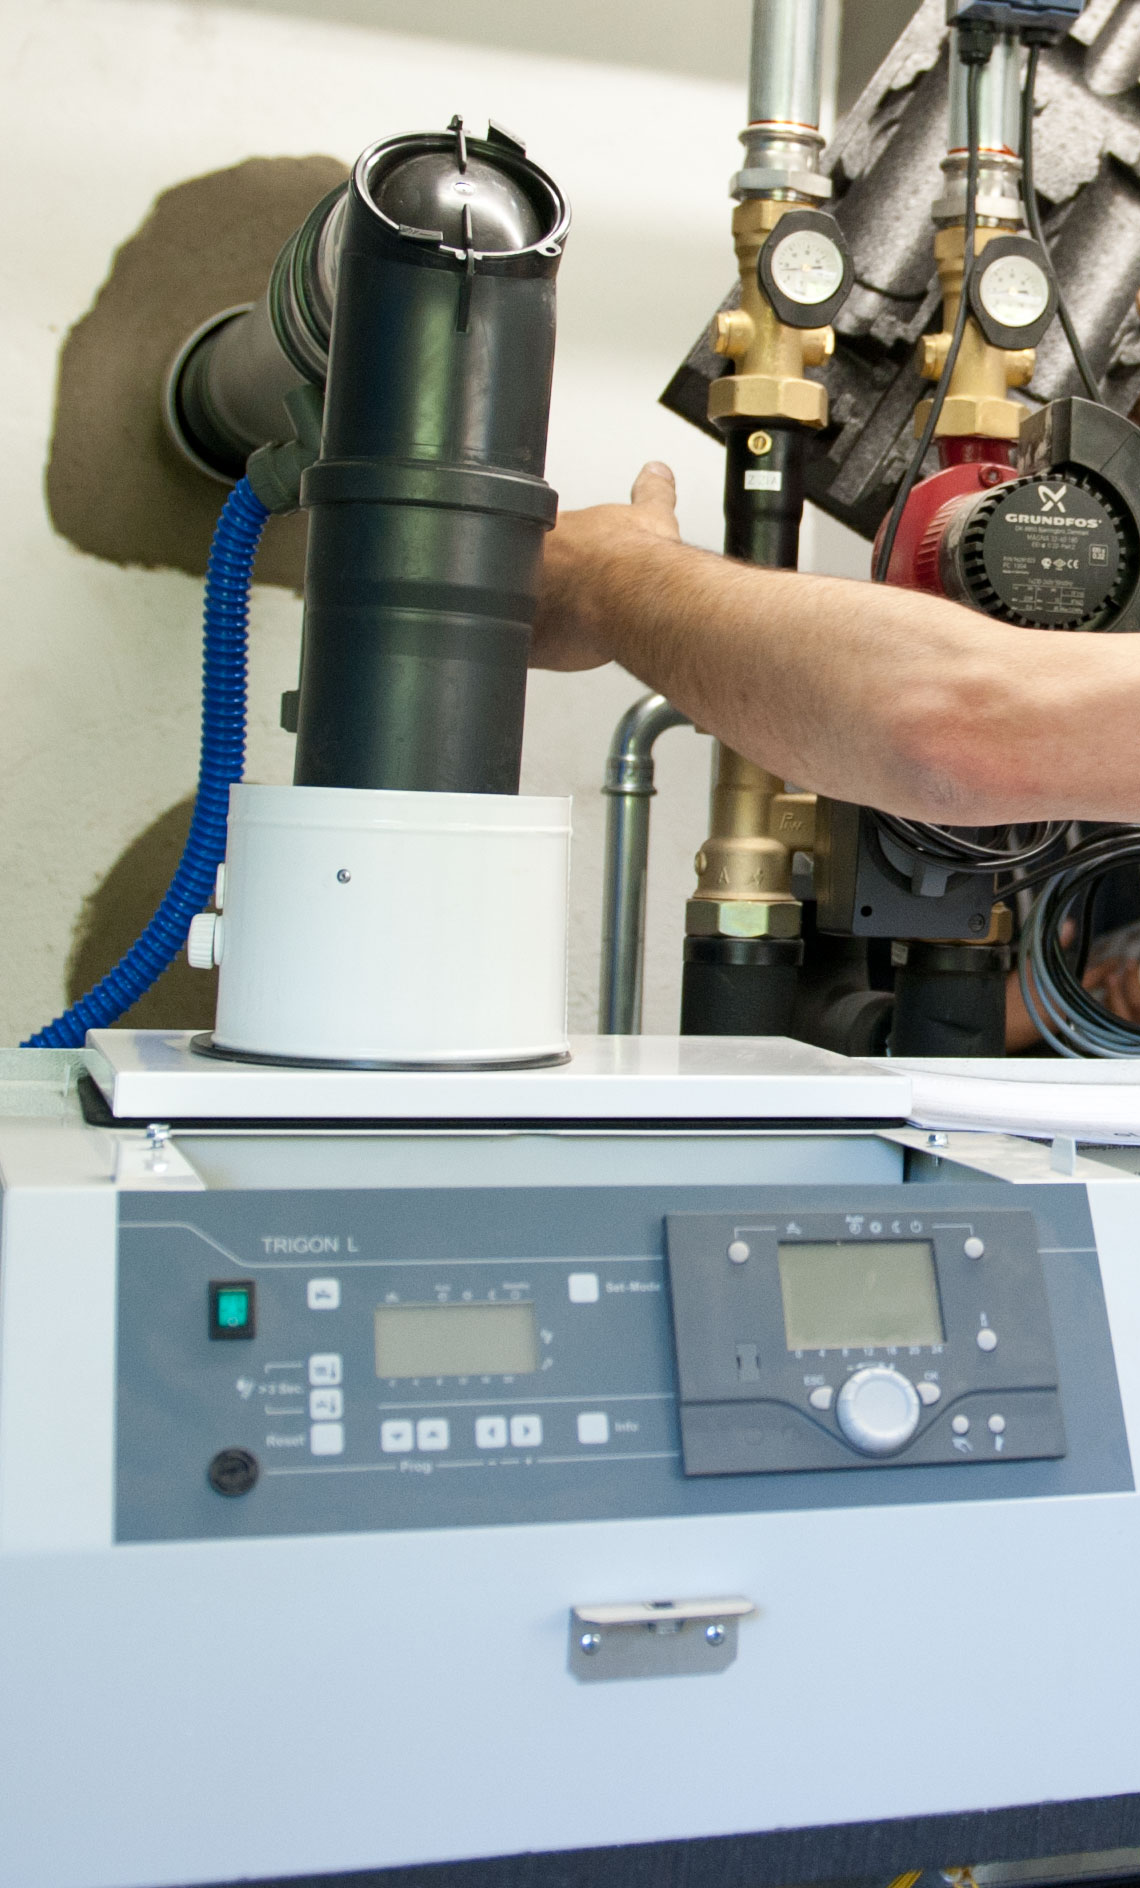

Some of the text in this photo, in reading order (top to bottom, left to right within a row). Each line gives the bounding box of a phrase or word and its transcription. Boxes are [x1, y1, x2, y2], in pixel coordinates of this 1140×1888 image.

[1005, 513, 1099, 529] GRUNDFOS
[261, 1236, 359, 1254] TRIGON L
[614, 1421, 640, 1433] Info
